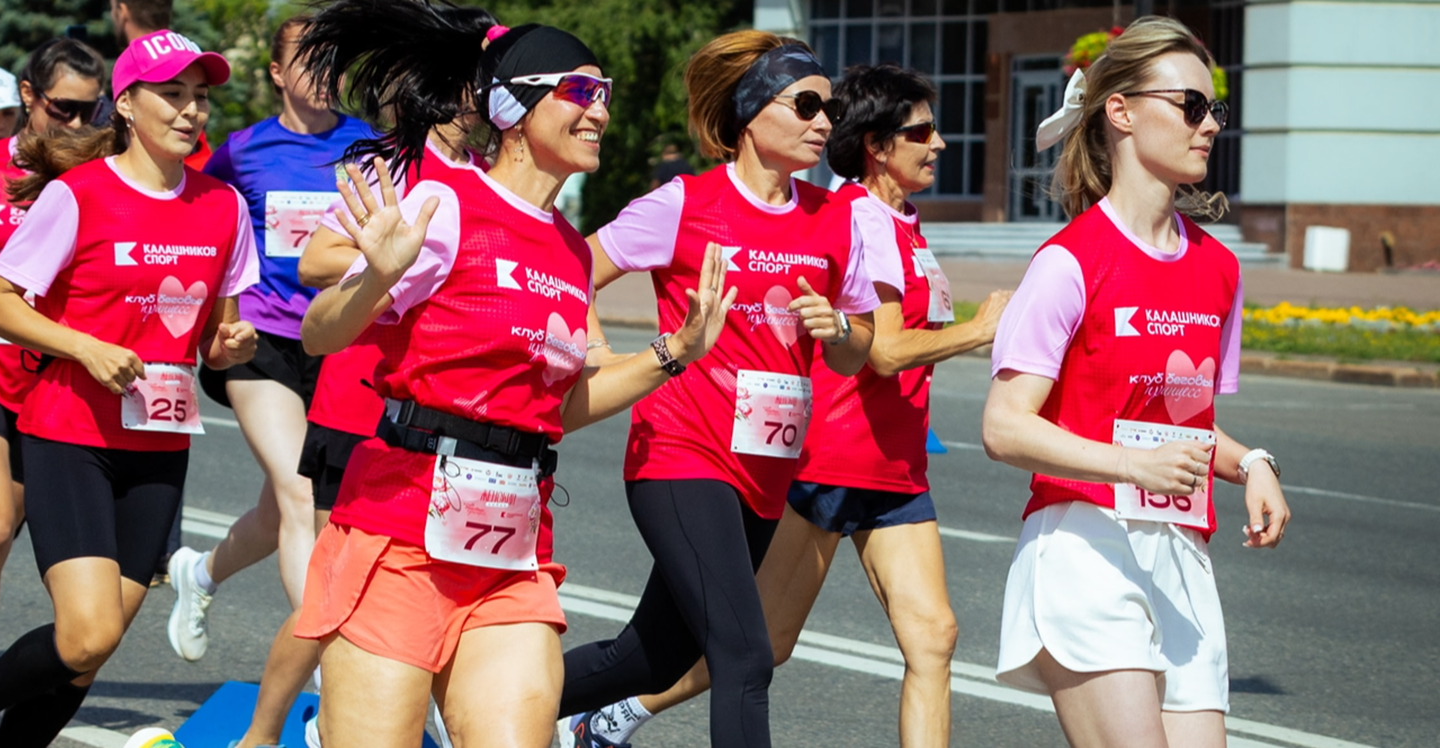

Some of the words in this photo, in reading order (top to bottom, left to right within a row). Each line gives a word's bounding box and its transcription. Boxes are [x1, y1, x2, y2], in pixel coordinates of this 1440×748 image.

[143, 244, 217, 257] КАЛАШНИКОВ
[144, 255, 179, 265] СПОРТ
[748, 261, 791, 275] СПОРТ
[527, 279, 561, 302] СПОРТ
[1145, 309, 1221, 328] КАЛАШНИКО
[511, 326, 545, 341] клуб
[1147, 322, 1185, 336] СПОРТ
[1129, 372, 1164, 386] клуб
[149, 398, 187, 422] 25
[764, 421, 797, 447] 70
[464, 521, 516, 555] 77
